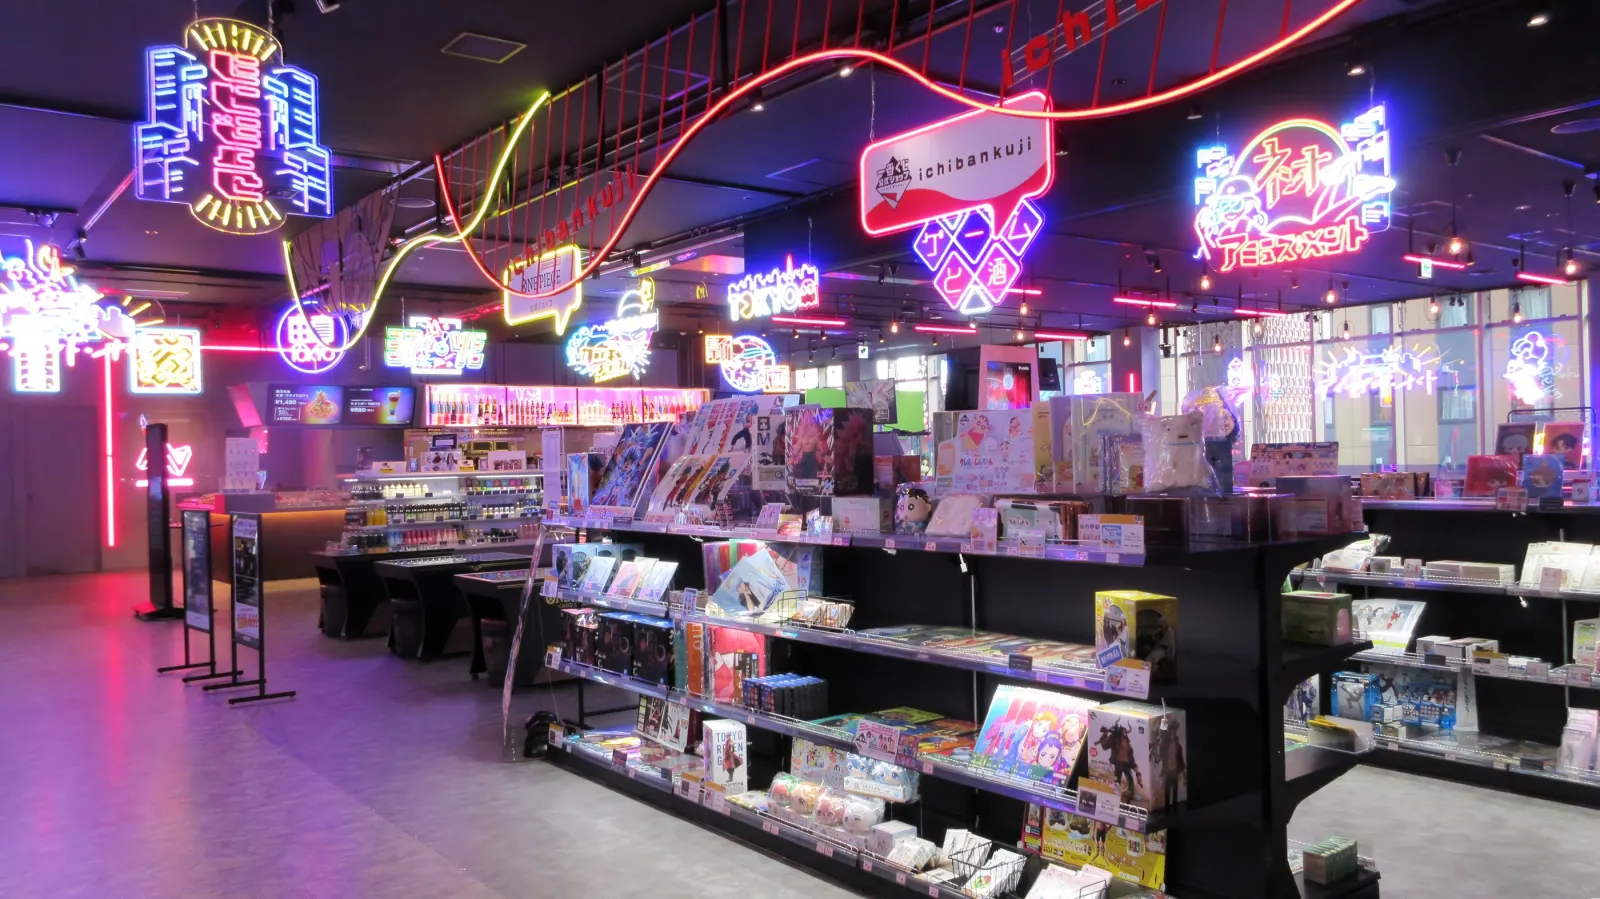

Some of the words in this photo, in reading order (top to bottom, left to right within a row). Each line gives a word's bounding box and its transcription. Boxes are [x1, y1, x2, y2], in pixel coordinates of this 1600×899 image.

[918, 136, 1032, 181] ichibankuji
[1253, 137, 1333, 210] ネオ
[521, 276, 538, 293] ONE
[538, 269, 561, 289] PIECE
[943, 256, 1007, 294] と酒
[716, 731, 743, 742] TOYO
[716, 743, 744, 754] REN
